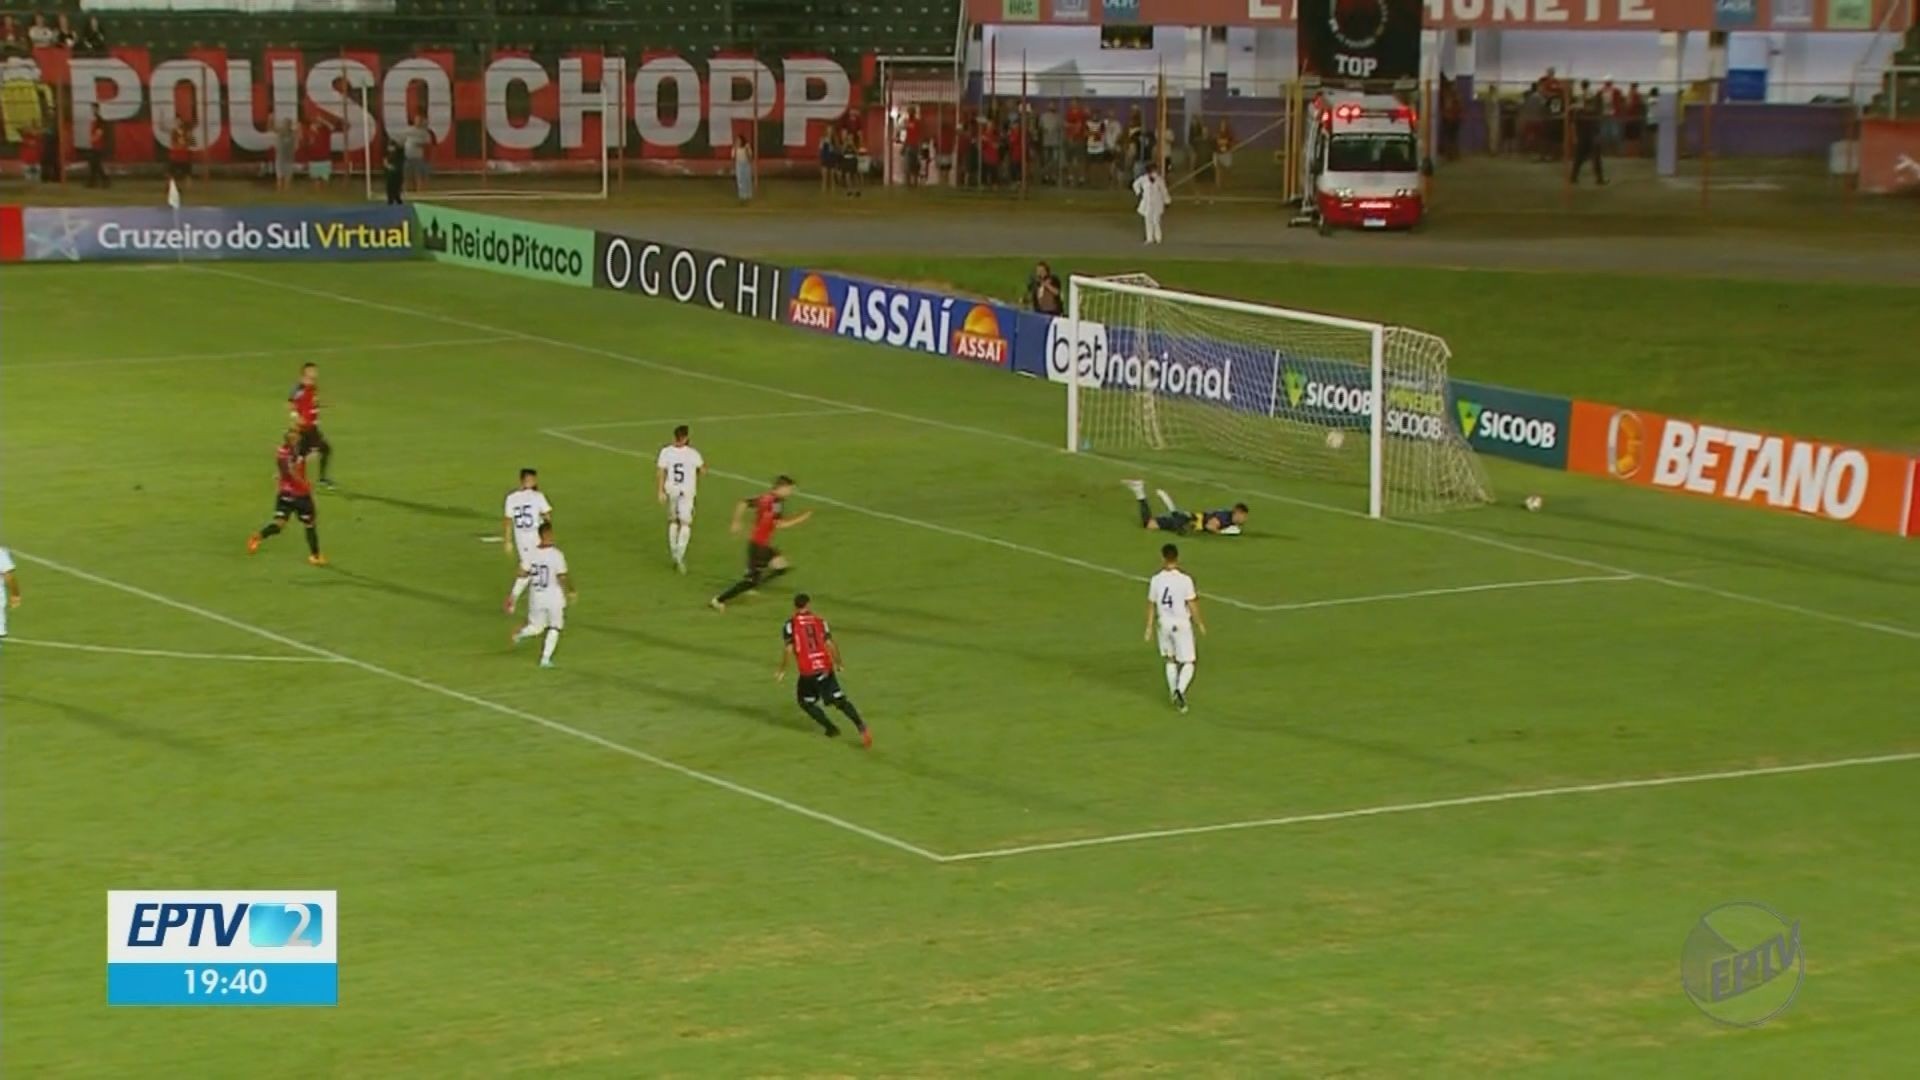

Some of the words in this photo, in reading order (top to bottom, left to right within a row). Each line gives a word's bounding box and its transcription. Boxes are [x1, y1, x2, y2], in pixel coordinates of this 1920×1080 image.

[1335, 54, 1378, 77] TOP
[69, 57, 453, 152] POUSO
[485, 57, 850, 151] CHOPP
[99, 223, 222, 250] Cruzeiro
[227, 222, 263, 249] do
[267, 223, 310, 249] Sul
[314, 222, 411, 249] Virtual
[606, 238, 780, 321] OGOCHI
[1306, 381, 1372, 415] SICOOB
[1386, 410, 1442, 439] SICOOB
[1479, 410, 1556, 448] SICOOB
[673, 463, 685, 484] 5
[1653, 419, 1869, 520] BETANO
[513, 505, 534, 529] 25
[1161, 586, 1173, 608] 4
